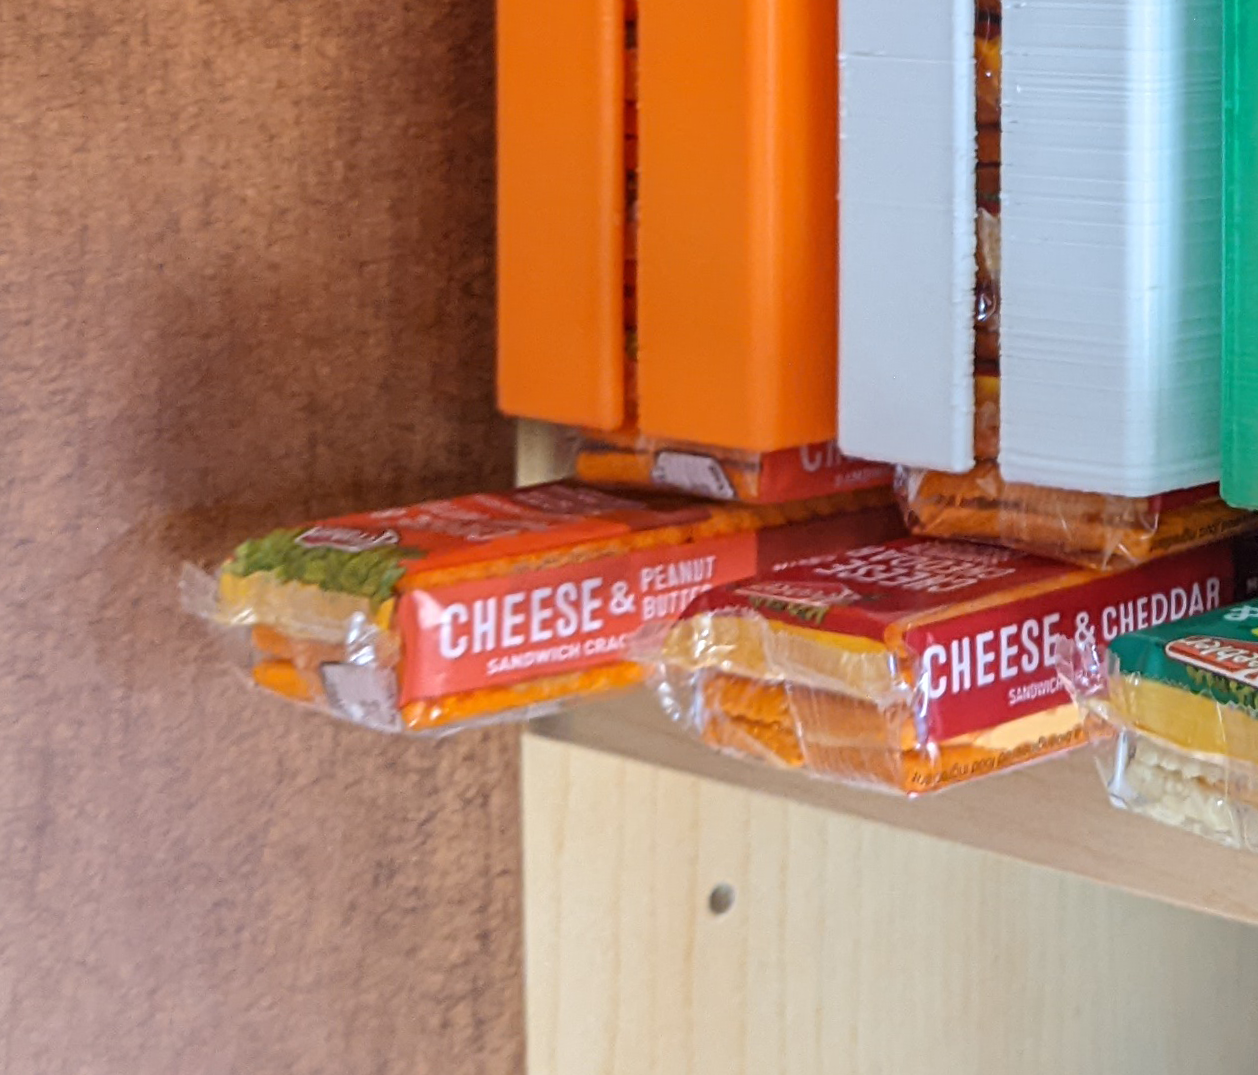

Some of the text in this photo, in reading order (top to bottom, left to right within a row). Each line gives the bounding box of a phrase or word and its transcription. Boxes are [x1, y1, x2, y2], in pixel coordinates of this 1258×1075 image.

[641, 555, 716, 593] PEANUT
[439, 577, 636, 661] CHEESE &
[643, 584, 712, 621] BUTT
[925, 577, 1221, 700] CHEESE & CHEDDAR
[486, 642, 581, 675] SANDWICH
